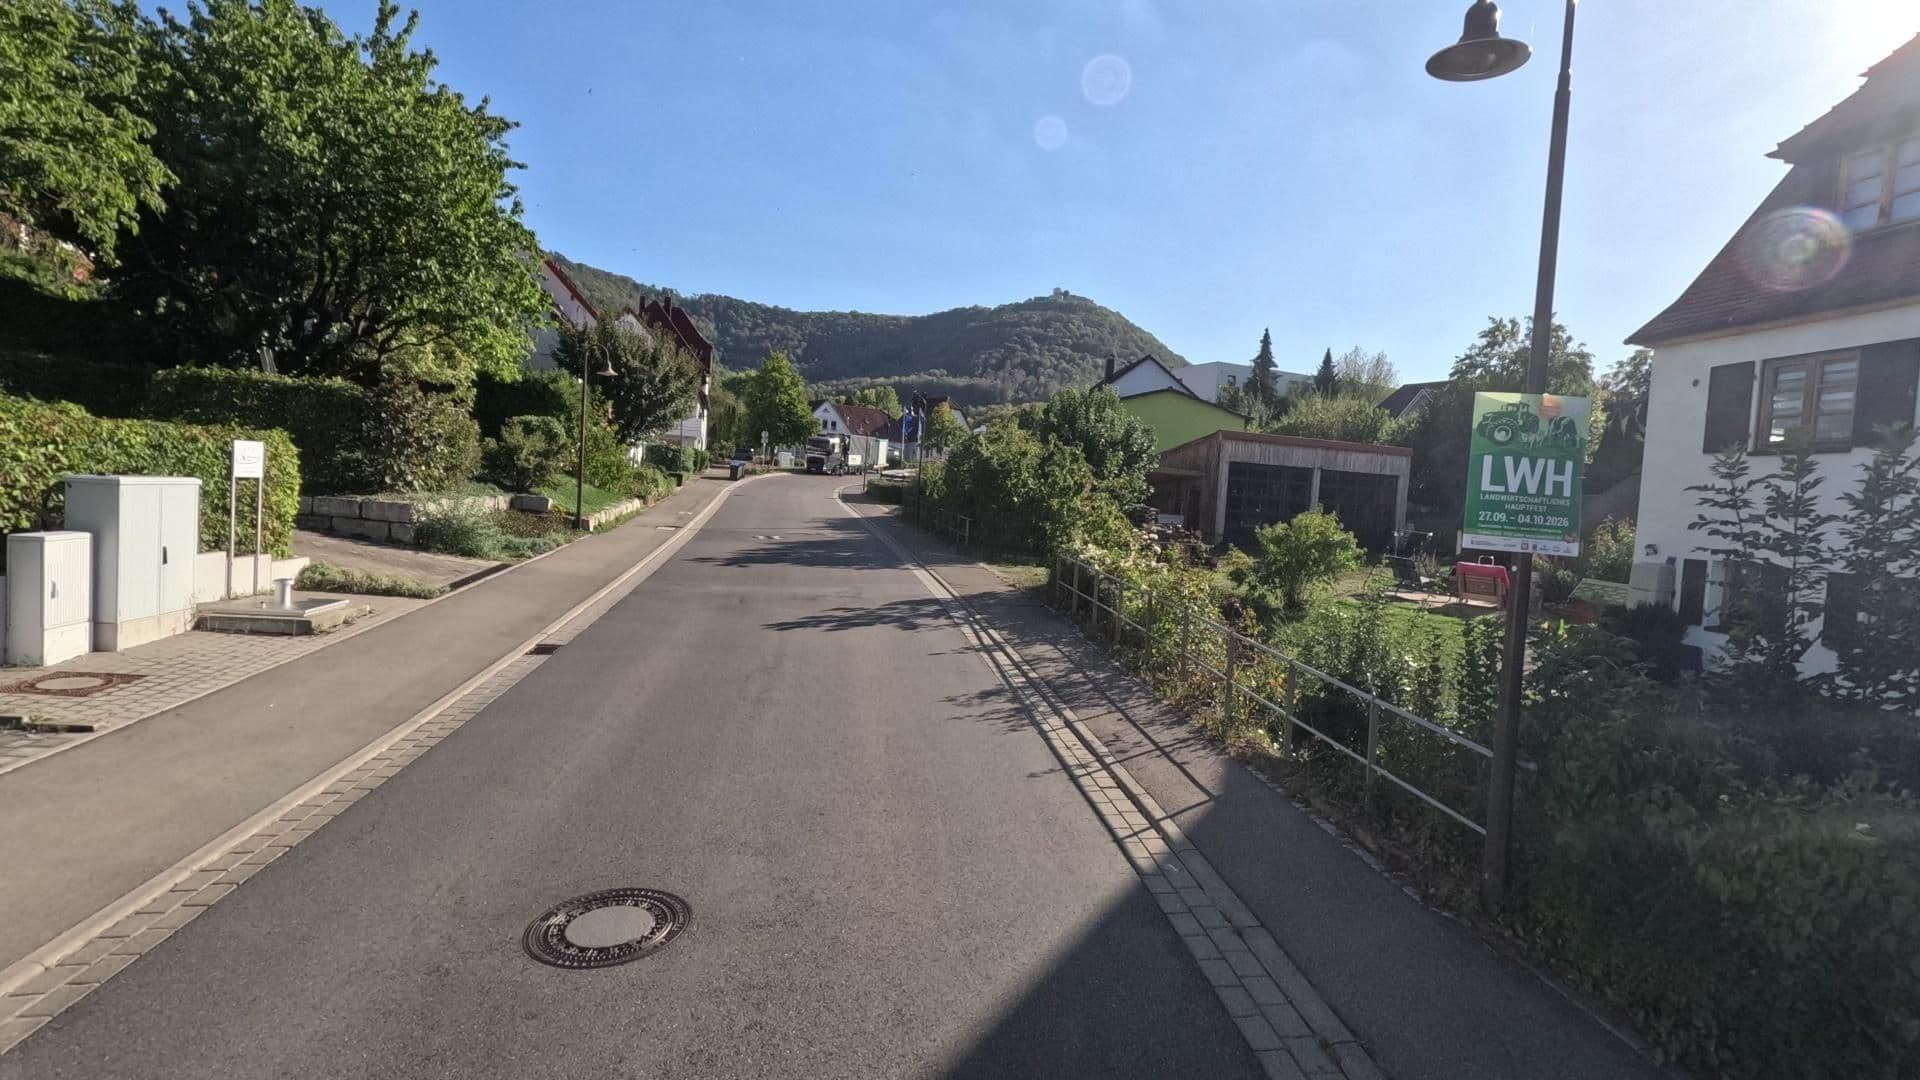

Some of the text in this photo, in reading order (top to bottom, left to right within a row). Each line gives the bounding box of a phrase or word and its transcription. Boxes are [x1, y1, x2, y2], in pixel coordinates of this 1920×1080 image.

[1481, 455, 1574, 497] LWH
[1480, 493, 1570, 506] LANDWIRTSCHAFTLICHES
[1504, 503, 1547, 512] HAUPTFEST
[1478, 510, 1508, 522] 27.09.
[1517, 513, 1569, 527] 04.10.2026
